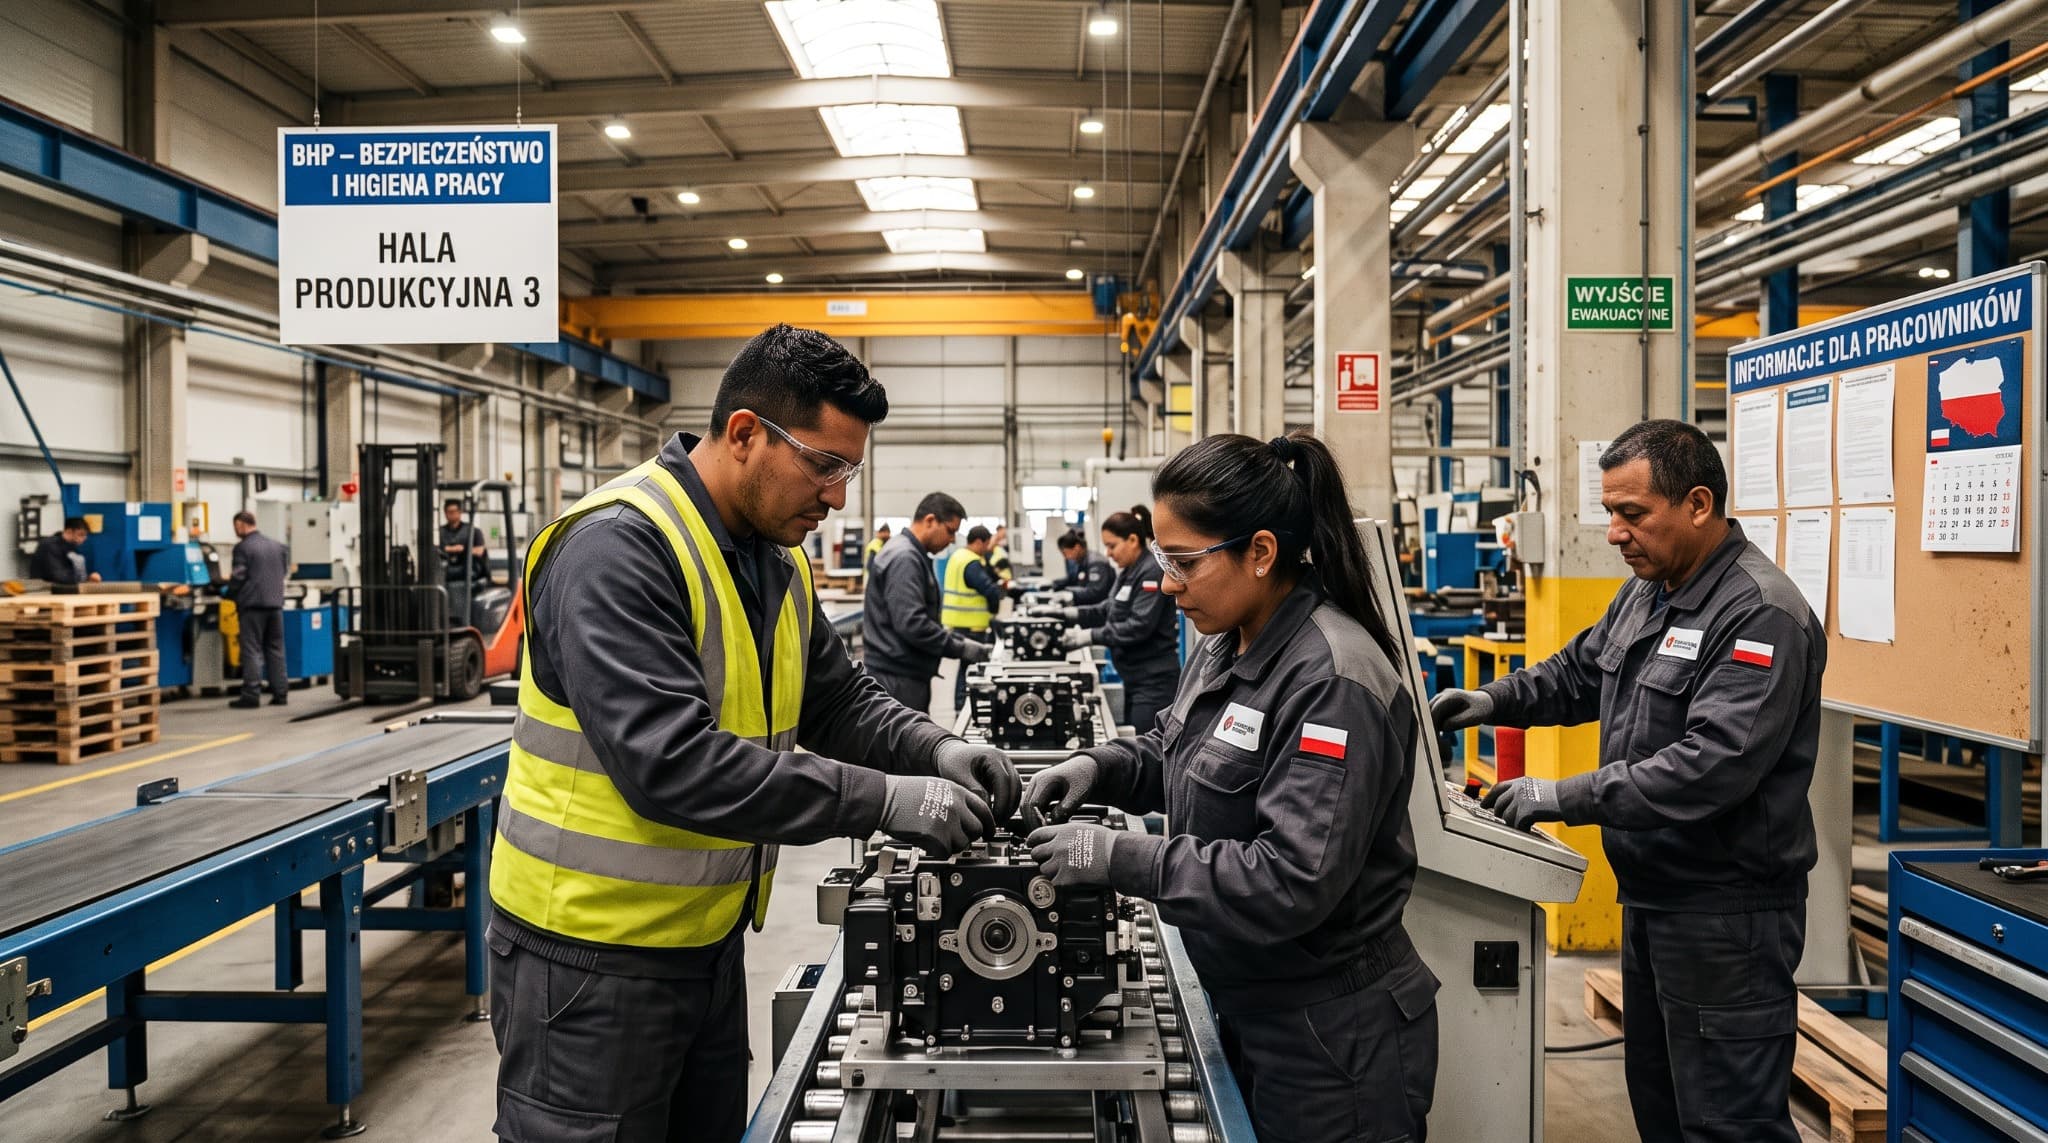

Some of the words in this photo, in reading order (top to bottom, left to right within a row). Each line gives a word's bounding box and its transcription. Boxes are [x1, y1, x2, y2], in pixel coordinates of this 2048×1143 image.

[292, 143, 335, 166] BHP
[360, 135, 544, 166] BEZPIECZEŃSTWO
[332, 174, 338, 197] I
[345, 173, 429, 197] HIGIENA
[435, 172, 504, 196] PRACY
[379, 232, 456, 264] HALA
[296, 277, 513, 309] PRODUKCYJNA
[524, 276, 541, 308] 3
[1735, 340, 1825, 385] INFORMACJE
[1829, 331, 1861, 365] DLA
[1866, 288, 2022, 355] PRACOWNIKÓW
